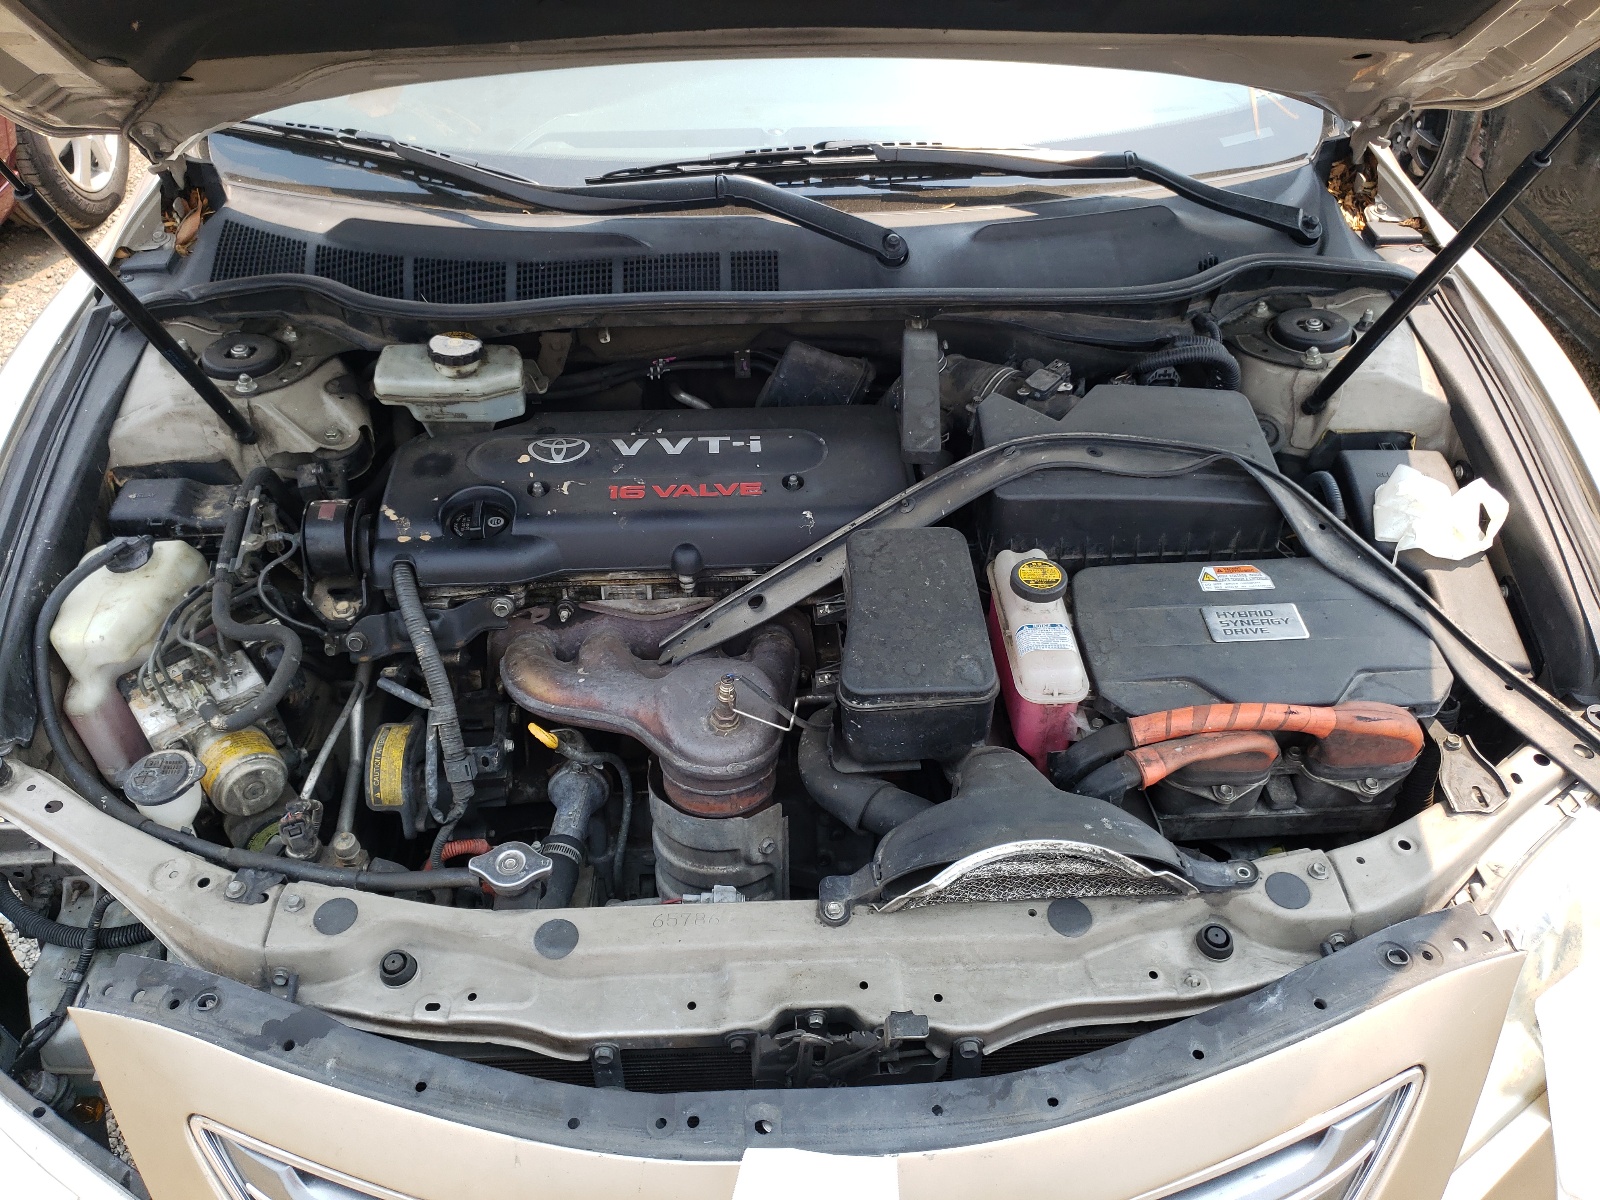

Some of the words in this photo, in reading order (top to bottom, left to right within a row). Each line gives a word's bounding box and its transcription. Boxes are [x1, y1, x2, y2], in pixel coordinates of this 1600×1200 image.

[611, 436, 762, 455] VVT-i
[608, 484, 646, 499] 16
[651, 481, 763, 498] VALVE
[1215, 609, 1274, 619] HYBRID
[1219, 617, 1290, 628] SYNERGY
[1222, 627, 1270, 636] DRIVE
[373, 756, 381, 786] CAUTION
